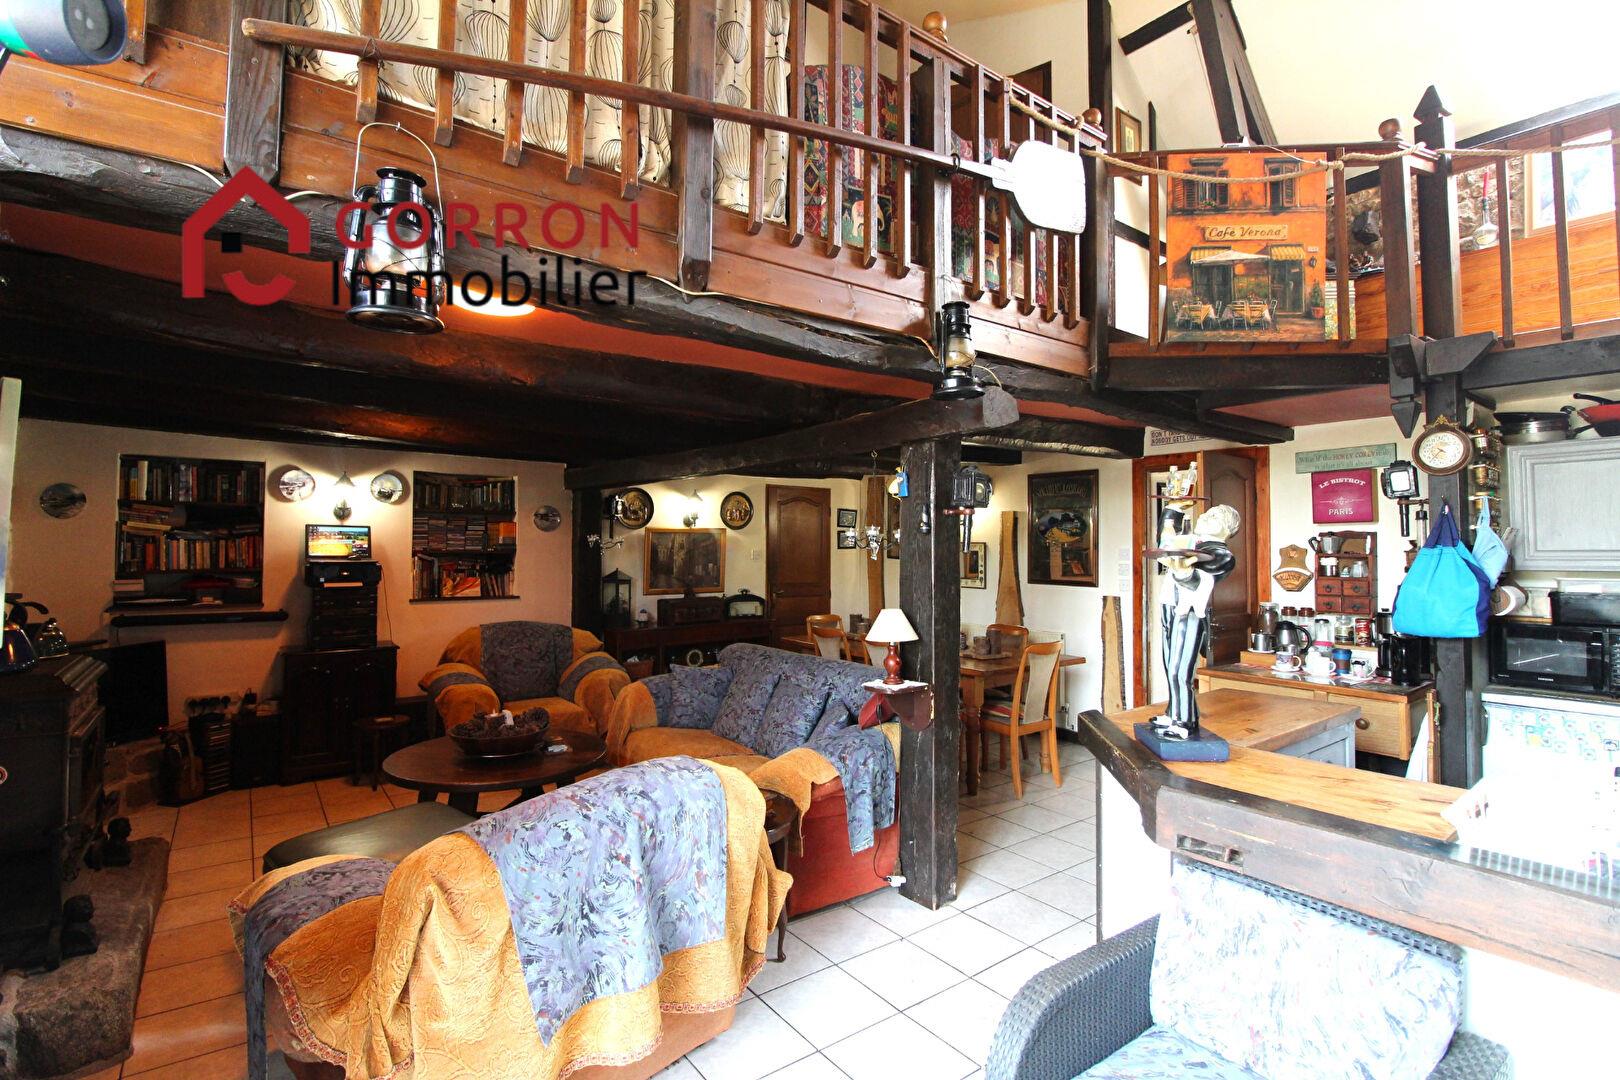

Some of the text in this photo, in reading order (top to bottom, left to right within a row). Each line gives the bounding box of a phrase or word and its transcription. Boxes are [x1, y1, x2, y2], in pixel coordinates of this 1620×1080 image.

[1240, 226, 1280, 237] Verona
[1172, 435, 1186, 443] GETS
[1319, 477, 1366, 489] LE BISTROT
[1328, 507, 1354, 516] PARIS
